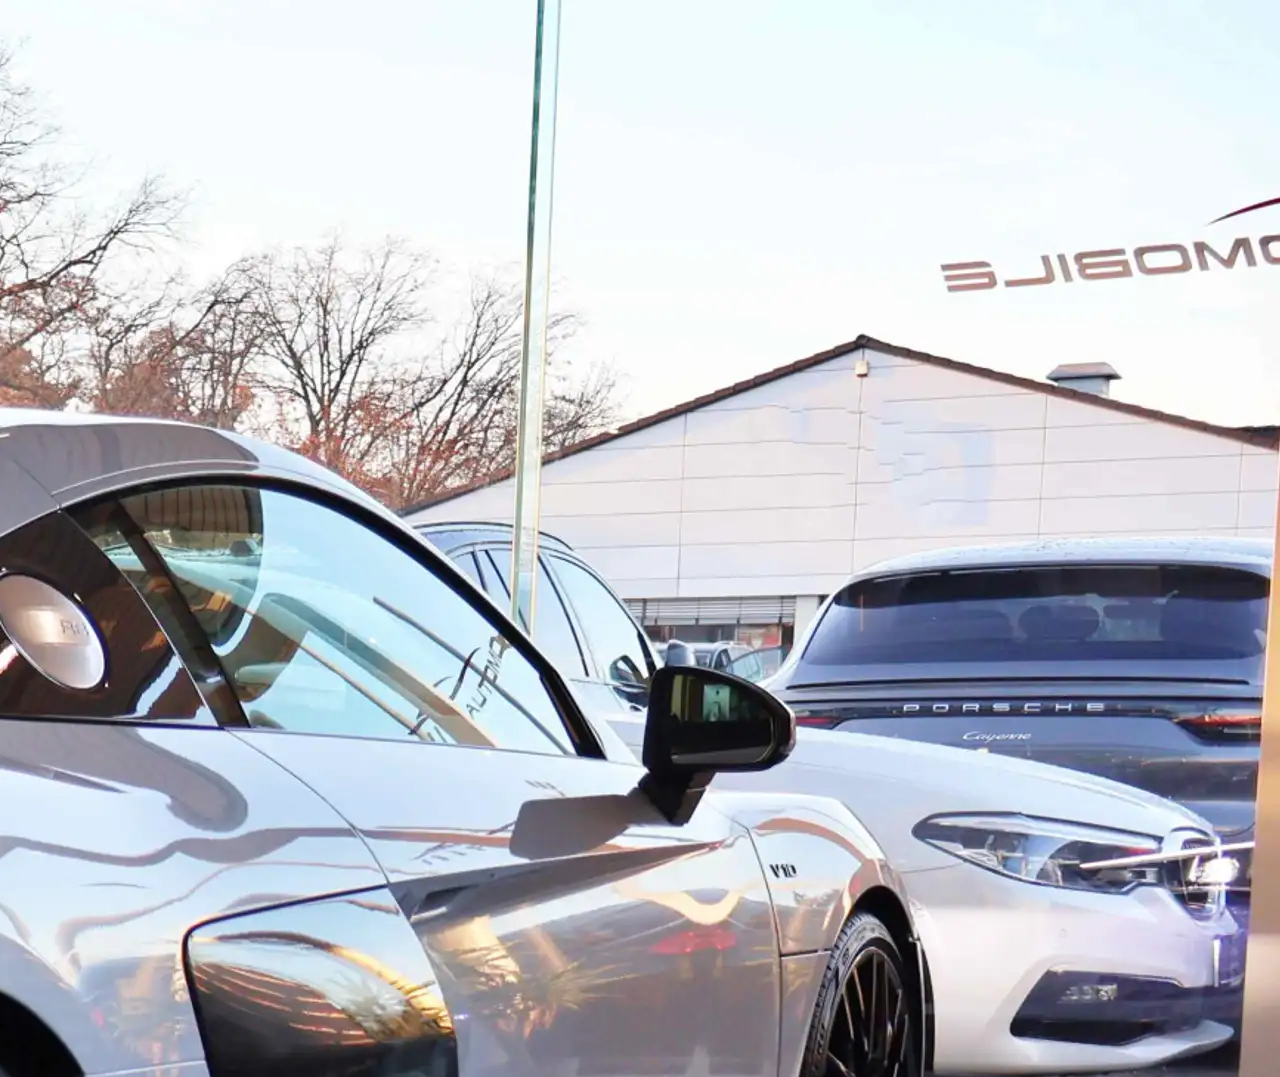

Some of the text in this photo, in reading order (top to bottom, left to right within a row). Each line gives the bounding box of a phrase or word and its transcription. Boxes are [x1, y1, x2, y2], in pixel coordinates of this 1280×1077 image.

[903, 703, 1105, 713] PORSCHE
[962, 730, 1032, 743] Cayenne
[769, 863, 797, 879] V10
